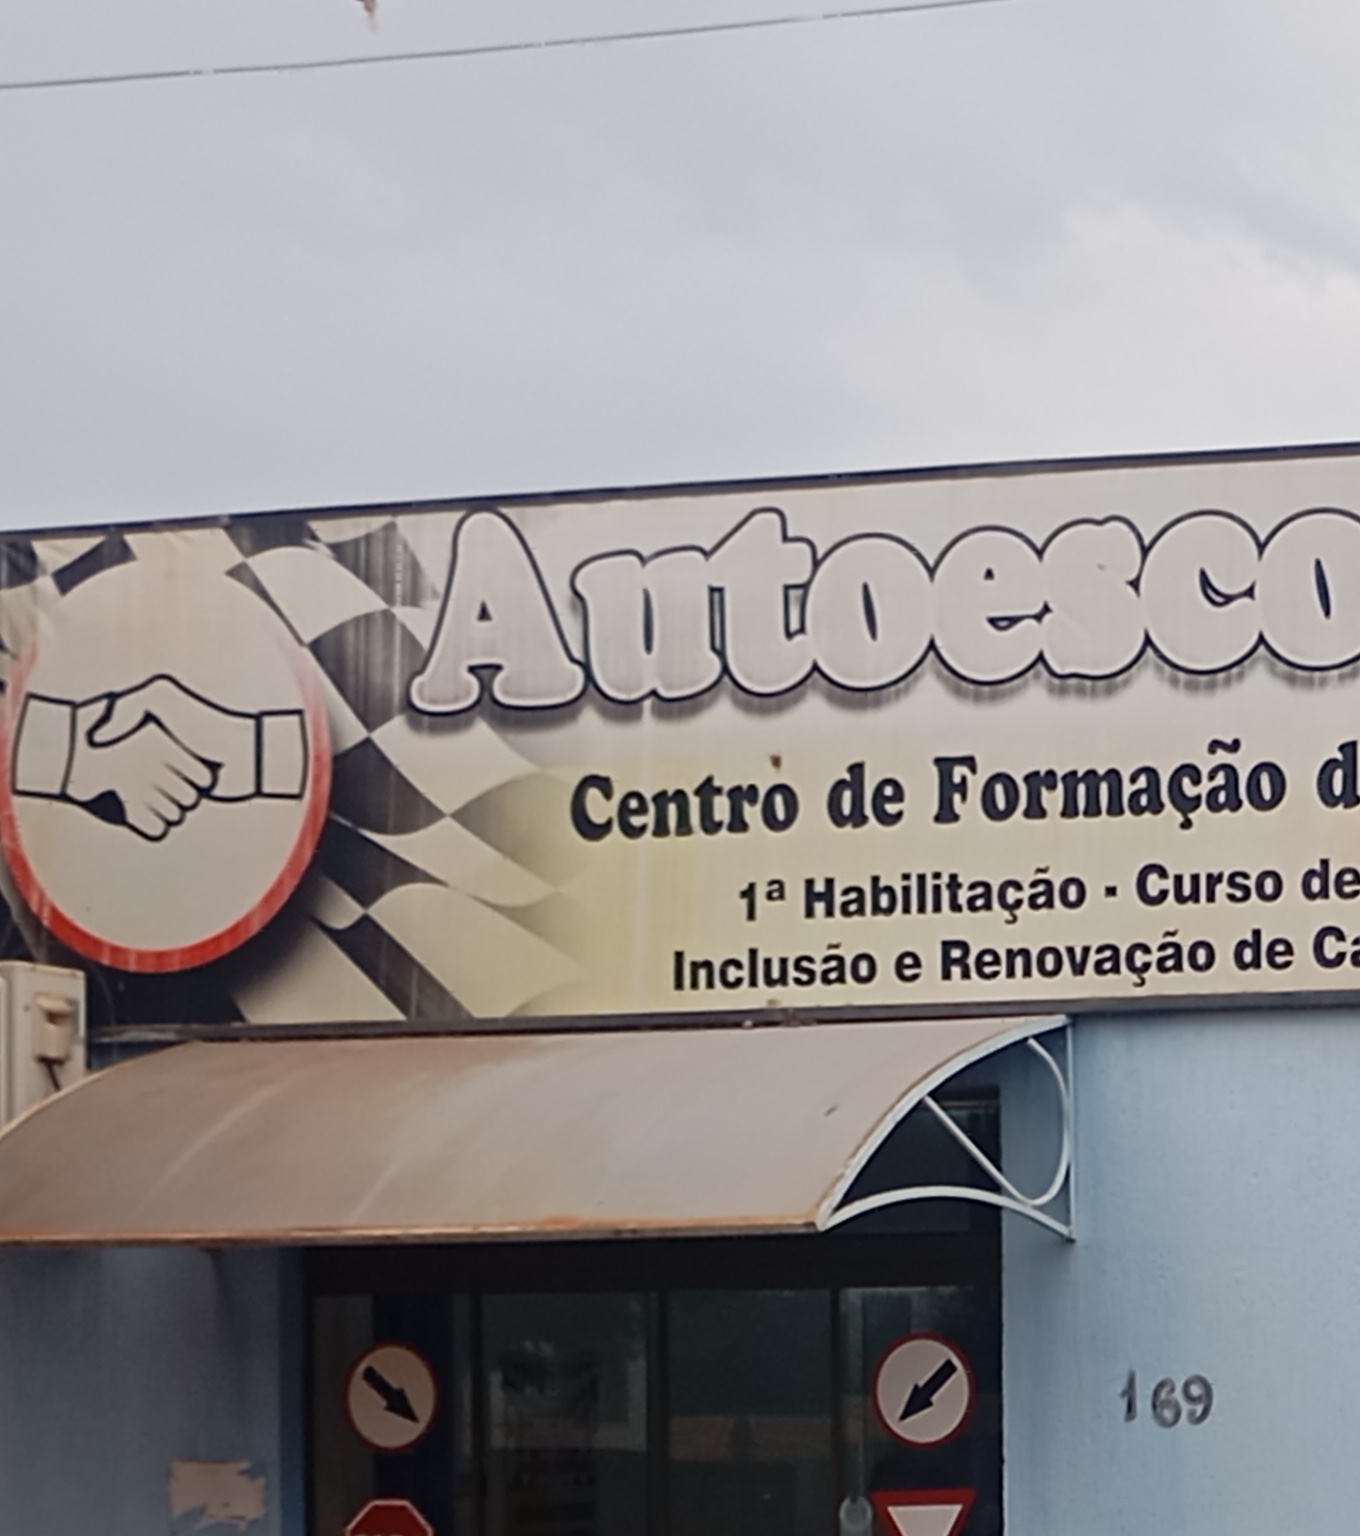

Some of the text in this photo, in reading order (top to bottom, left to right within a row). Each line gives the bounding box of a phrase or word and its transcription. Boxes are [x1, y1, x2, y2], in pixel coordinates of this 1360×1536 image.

[571, 774, 799, 841] Centro
[827, 762, 905, 829] de
[933, 738, 1287, 830] Formação
[739, 879, 785, 922] 1ª
[804, 867, 1087, 925] Habilitação
[1136, 864, 1283, 906] Curso
[674, 943, 877, 991] Inclusão
[894, 952, 922, 982] e
[941, 930, 1216, 988] Renovação
[1233, 929, 1295, 971] de
[1119, 1368, 1214, 1429] 169
